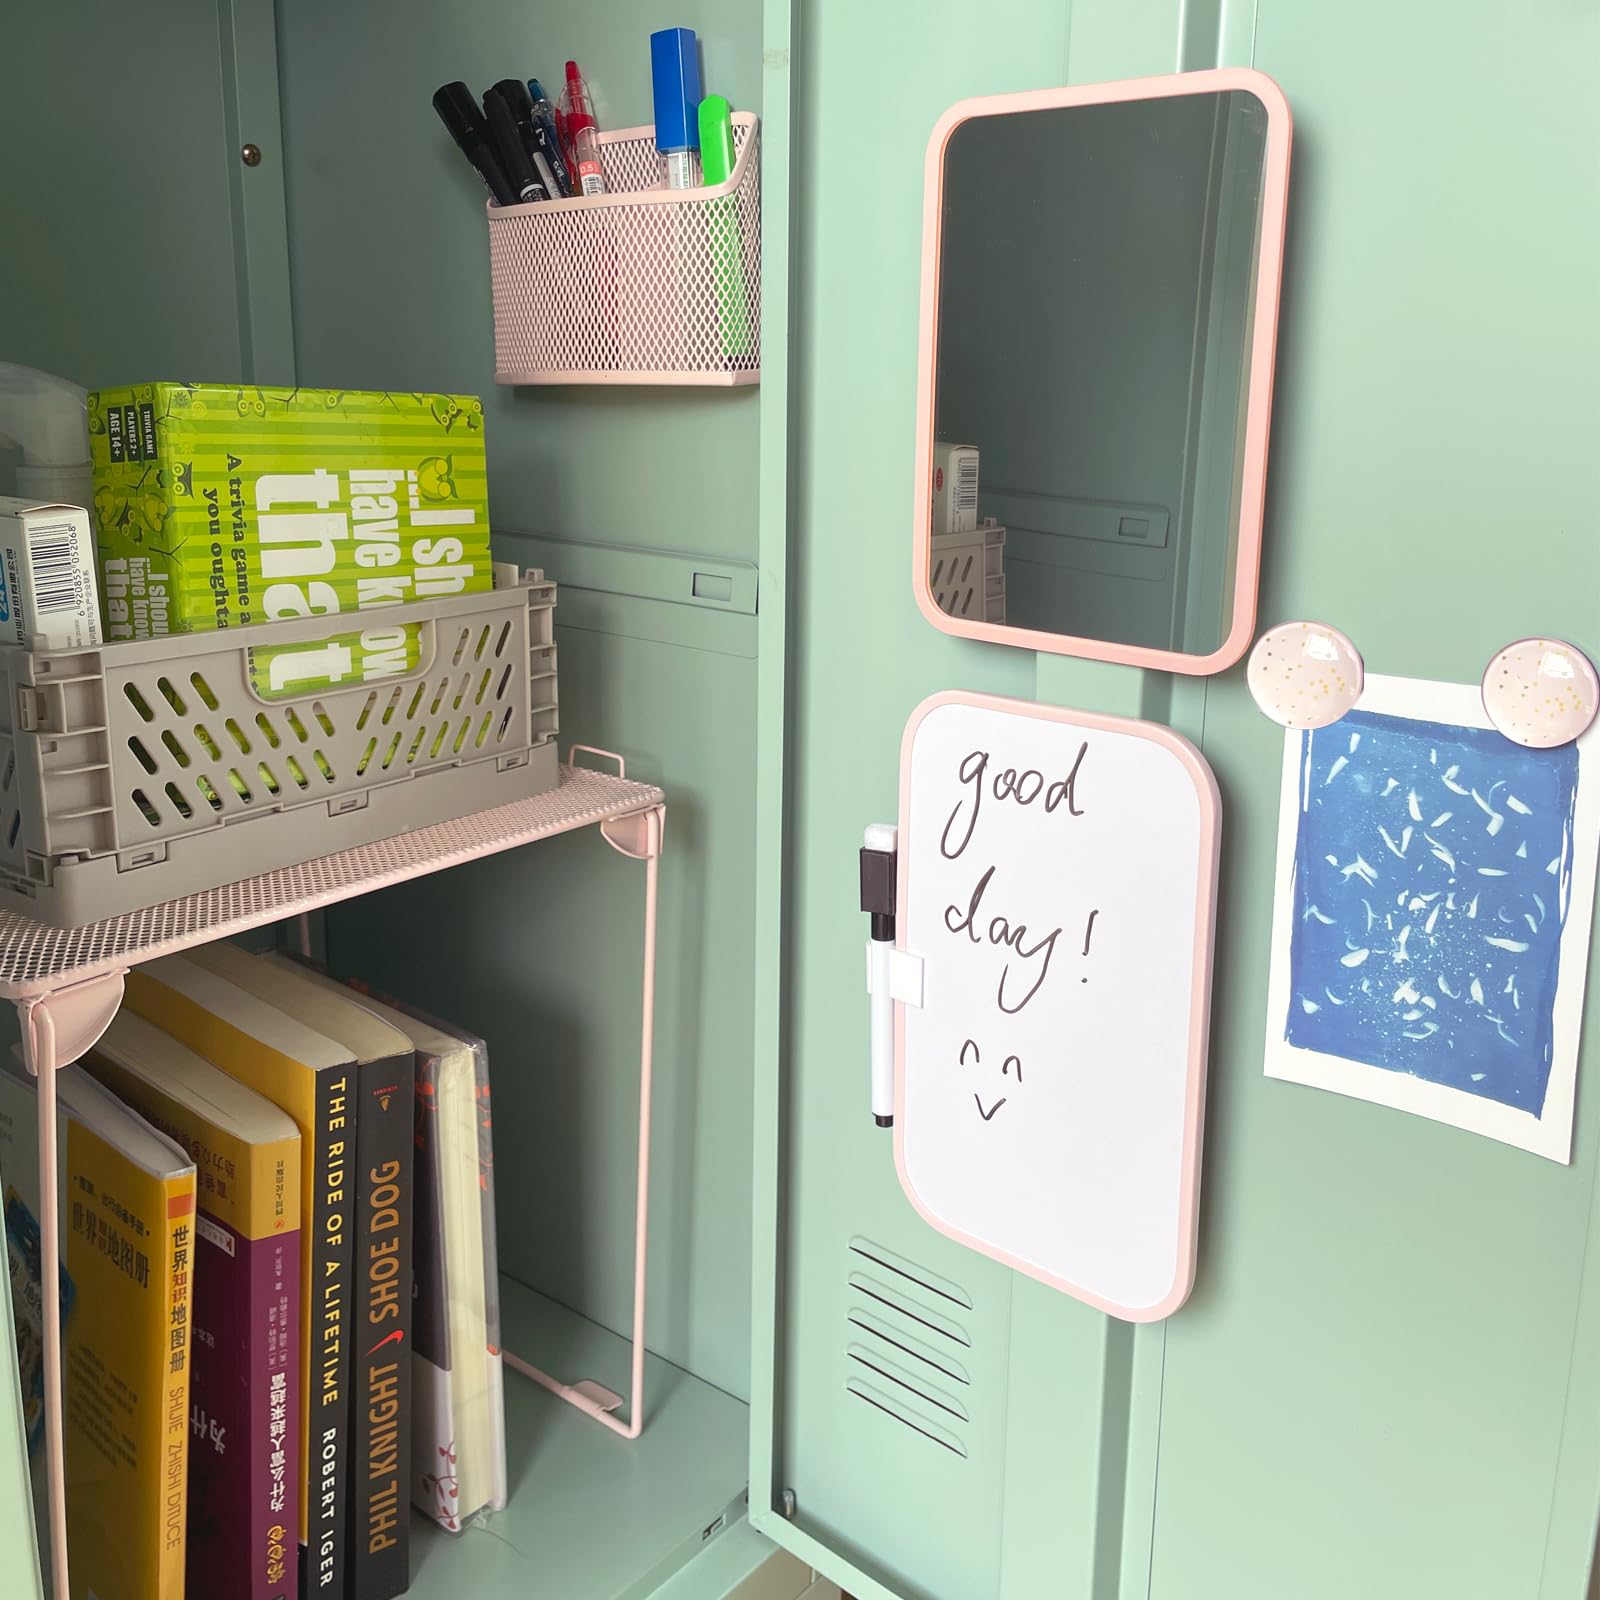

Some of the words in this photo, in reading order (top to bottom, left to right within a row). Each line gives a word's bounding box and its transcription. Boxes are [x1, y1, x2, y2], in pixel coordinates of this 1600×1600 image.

[109, 412, 120, 434] AGE
[111, 437, 122, 457] 14+
[127, 411, 137, 443] PLAYERS
[130, 445, 138, 456] 2+
[144, 410, 152, 433] TRIVIA
[145, 434, 154, 455] GAME
[226, 453, 243, 473] A
[203, 487, 222, 536] you
[228, 477, 248, 543] trivia
[349, 470, 405, 568] have
[105, 557, 133, 638] that
[129, 557, 146, 596] have
[209, 542, 230, 630] oughta
[231, 548, 251, 607] game
[255, 468, 353, 691] that
[940, 741, 1089, 860] good
[329, 1077, 347, 1132] THE
[327, 1141, 345, 1206] RIDE
[370, 1160, 401, 1233] DOG
[326, 1213, 343, 1246] OF
[170, 1224, 190, 1374] 世界知识地图册
[325, 1261, 341, 1278] A
[369, 1237, 401, 1325] SHOE
[322, 1283, 341, 1407] LIFETIME
[169, 1386, 184, 1435] SHIJIE
[368, 1361, 400, 1480] KNIGHT
[168, 1440, 183, 1490] ZHISHI
[269, 1372, 287, 1512] 为什么富人越来越富
[320, 1427, 337, 1520] ROBERT
[166, 1492, 182, 1551] DITUCE
[368, 1479, 398, 1555] PHIL
[319, 1529, 335, 1588] IGER
